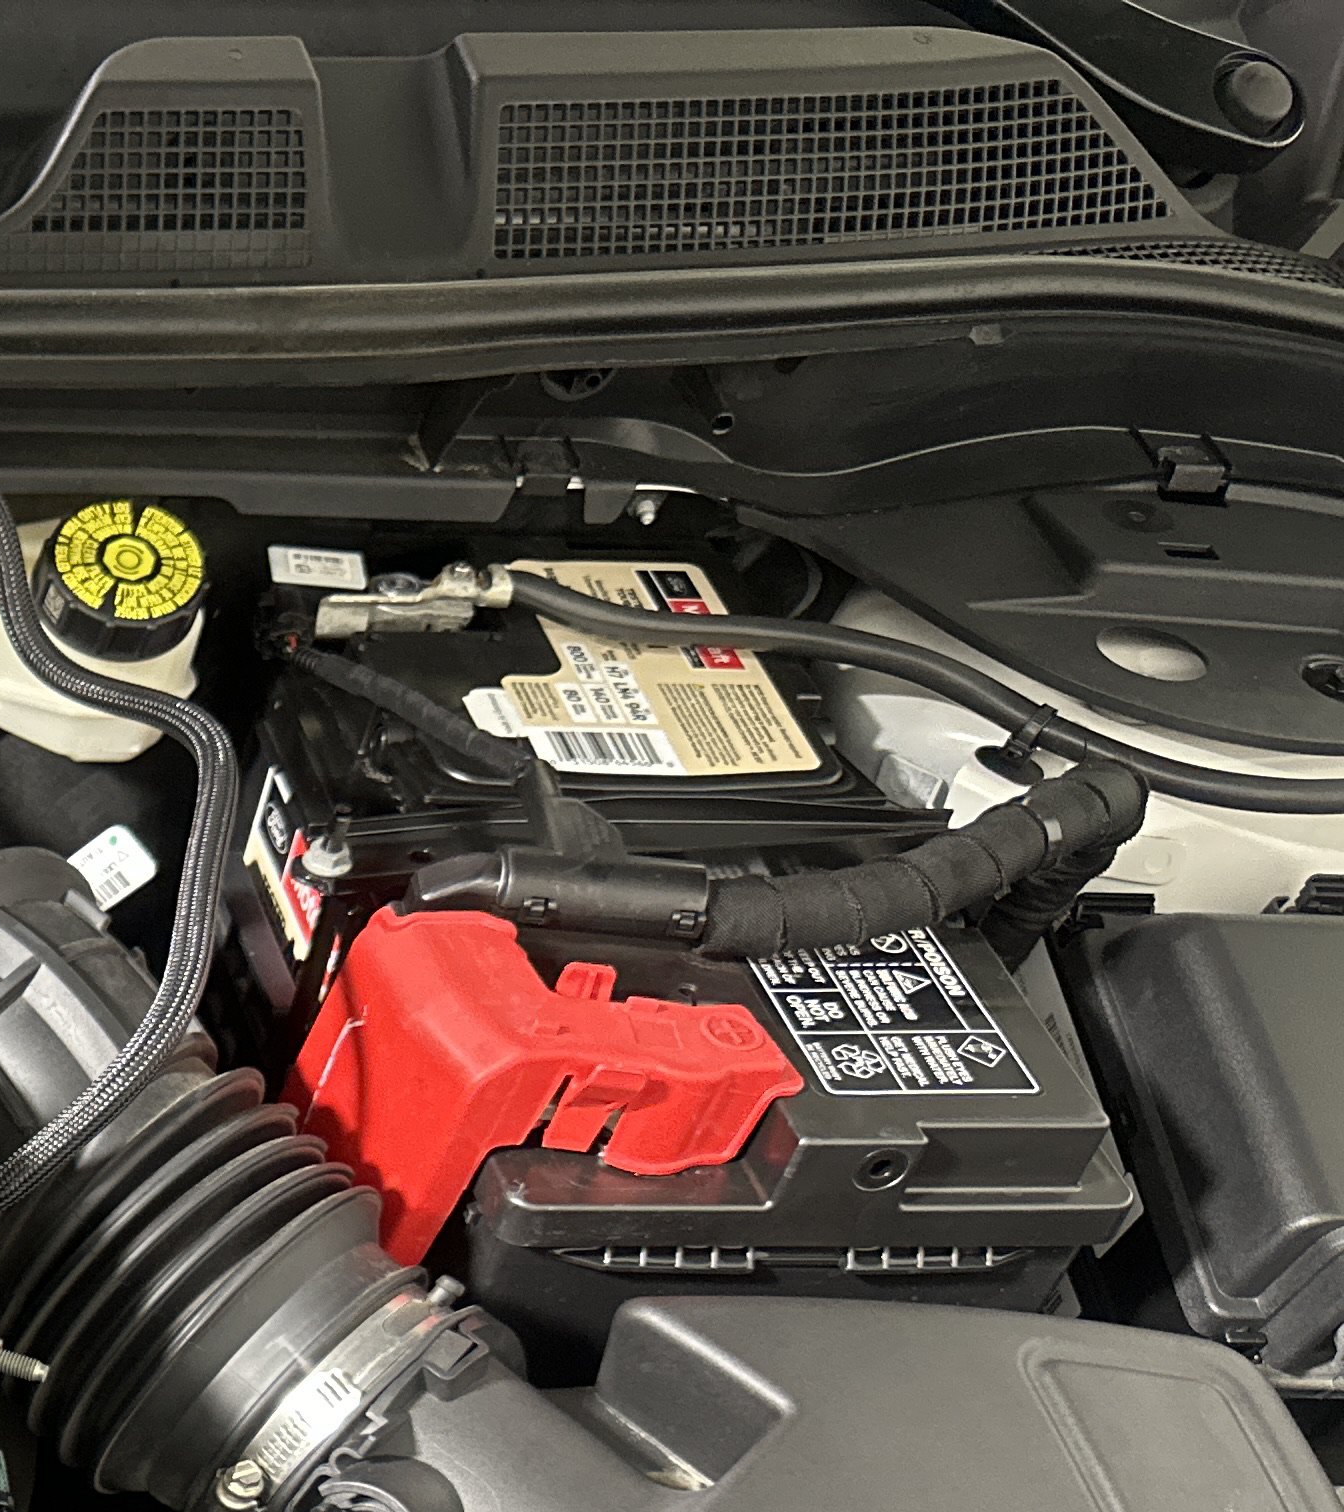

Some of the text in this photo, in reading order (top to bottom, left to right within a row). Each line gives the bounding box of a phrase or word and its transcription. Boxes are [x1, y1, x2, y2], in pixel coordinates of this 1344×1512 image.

[567, 646, 588, 662] 800
[909, 930, 965, 995] R/POISON
[786, 995, 815, 1028] OPEN.
[804, 999, 830, 1022] NOT
[823, 1002, 844, 1018] DO
